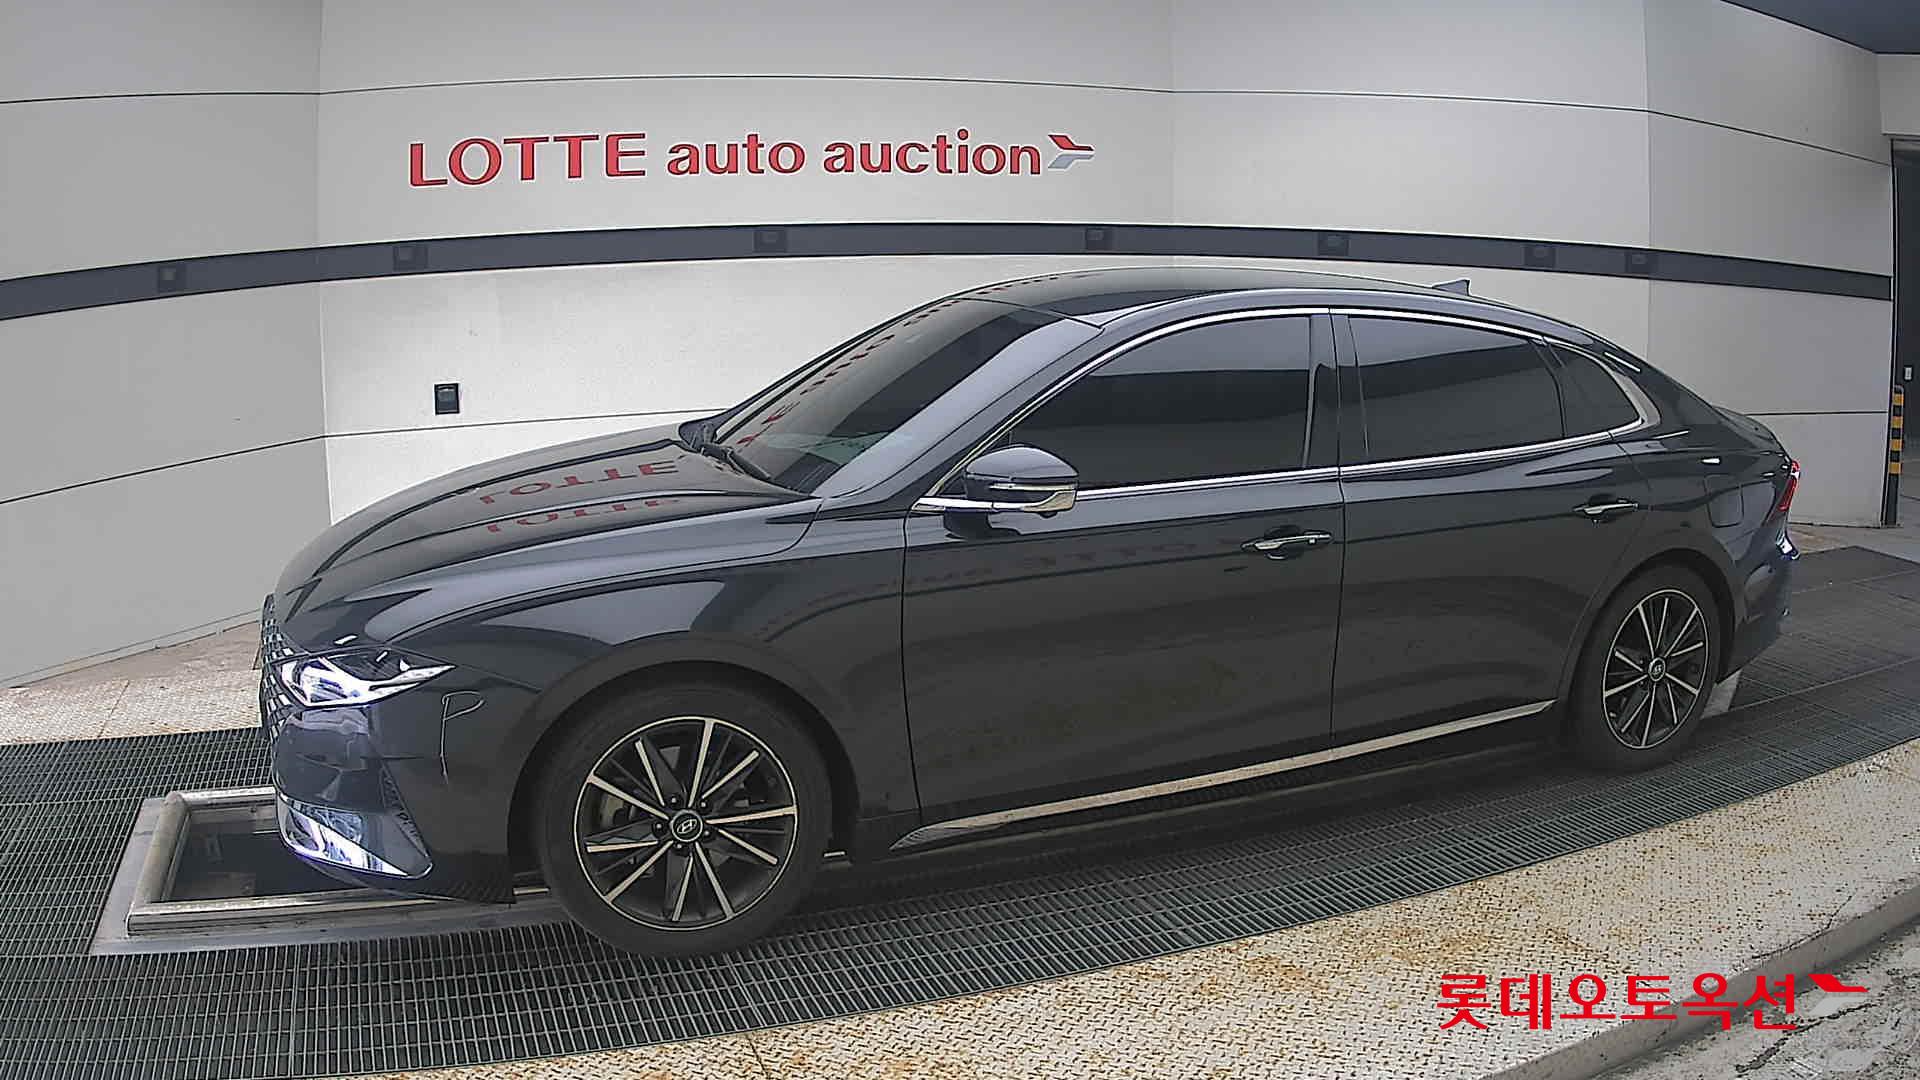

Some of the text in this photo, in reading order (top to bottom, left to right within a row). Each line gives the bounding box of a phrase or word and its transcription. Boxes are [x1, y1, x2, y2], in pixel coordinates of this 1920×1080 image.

[409, 130, 1041, 187] LOTTE auto auction
